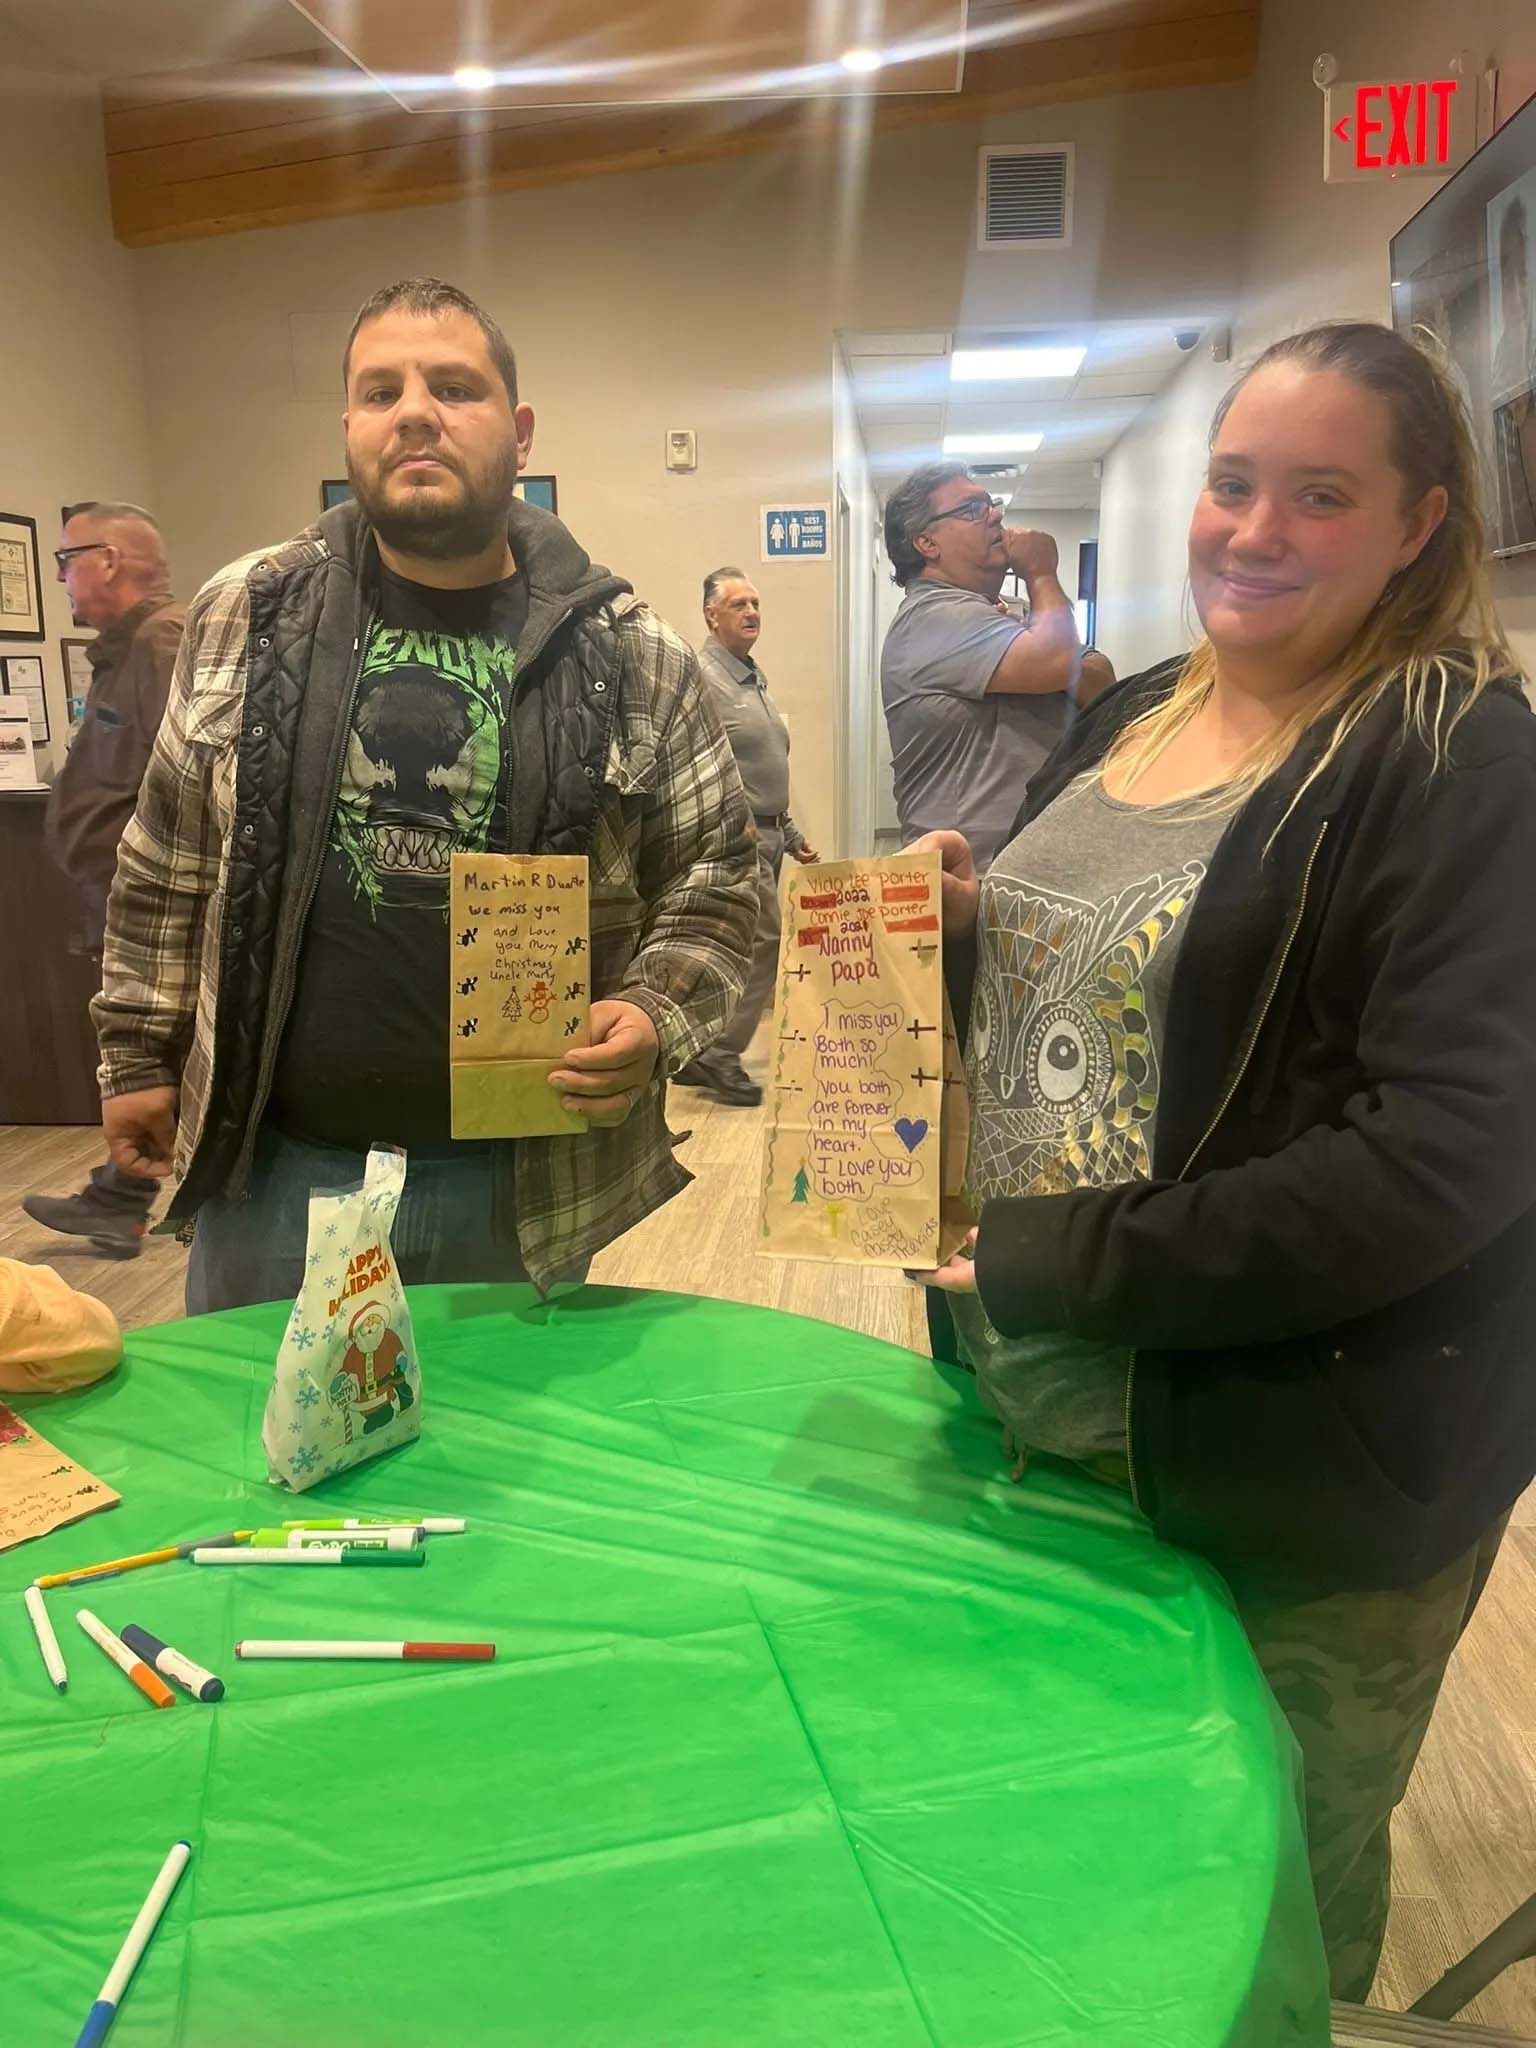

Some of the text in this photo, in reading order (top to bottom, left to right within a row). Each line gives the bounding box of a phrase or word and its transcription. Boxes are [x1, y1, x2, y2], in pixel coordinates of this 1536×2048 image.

[1356, 80, 1458, 169] EXIT
[364, 619, 516, 690] ENOM
[464, 872, 526, 892] Martin
[531, 872, 541, 888] R
[836, 889, 871, 906] 2022
[499, 902, 527, 914] miss
[534, 905, 561, 920] you
[493, 924, 519, 936] and
[495, 939, 559, 957] you Merry
[818, 931, 874, 961] Nanny
[495, 956, 553, 971] Christmas
[489, 970, 521, 981] Uncle
[838, 1014, 873, 1031] miss
[874, 1012, 898, 1037] you
[816, 1034, 855, 1054] Both
[859, 1079, 891, 1097] both
[845, 1100, 891, 1116] forever
[818, 1117, 867, 1140] in my
[817, 1157, 913, 1184] I Love you
[347, 1245, 382, 1275] APPY
